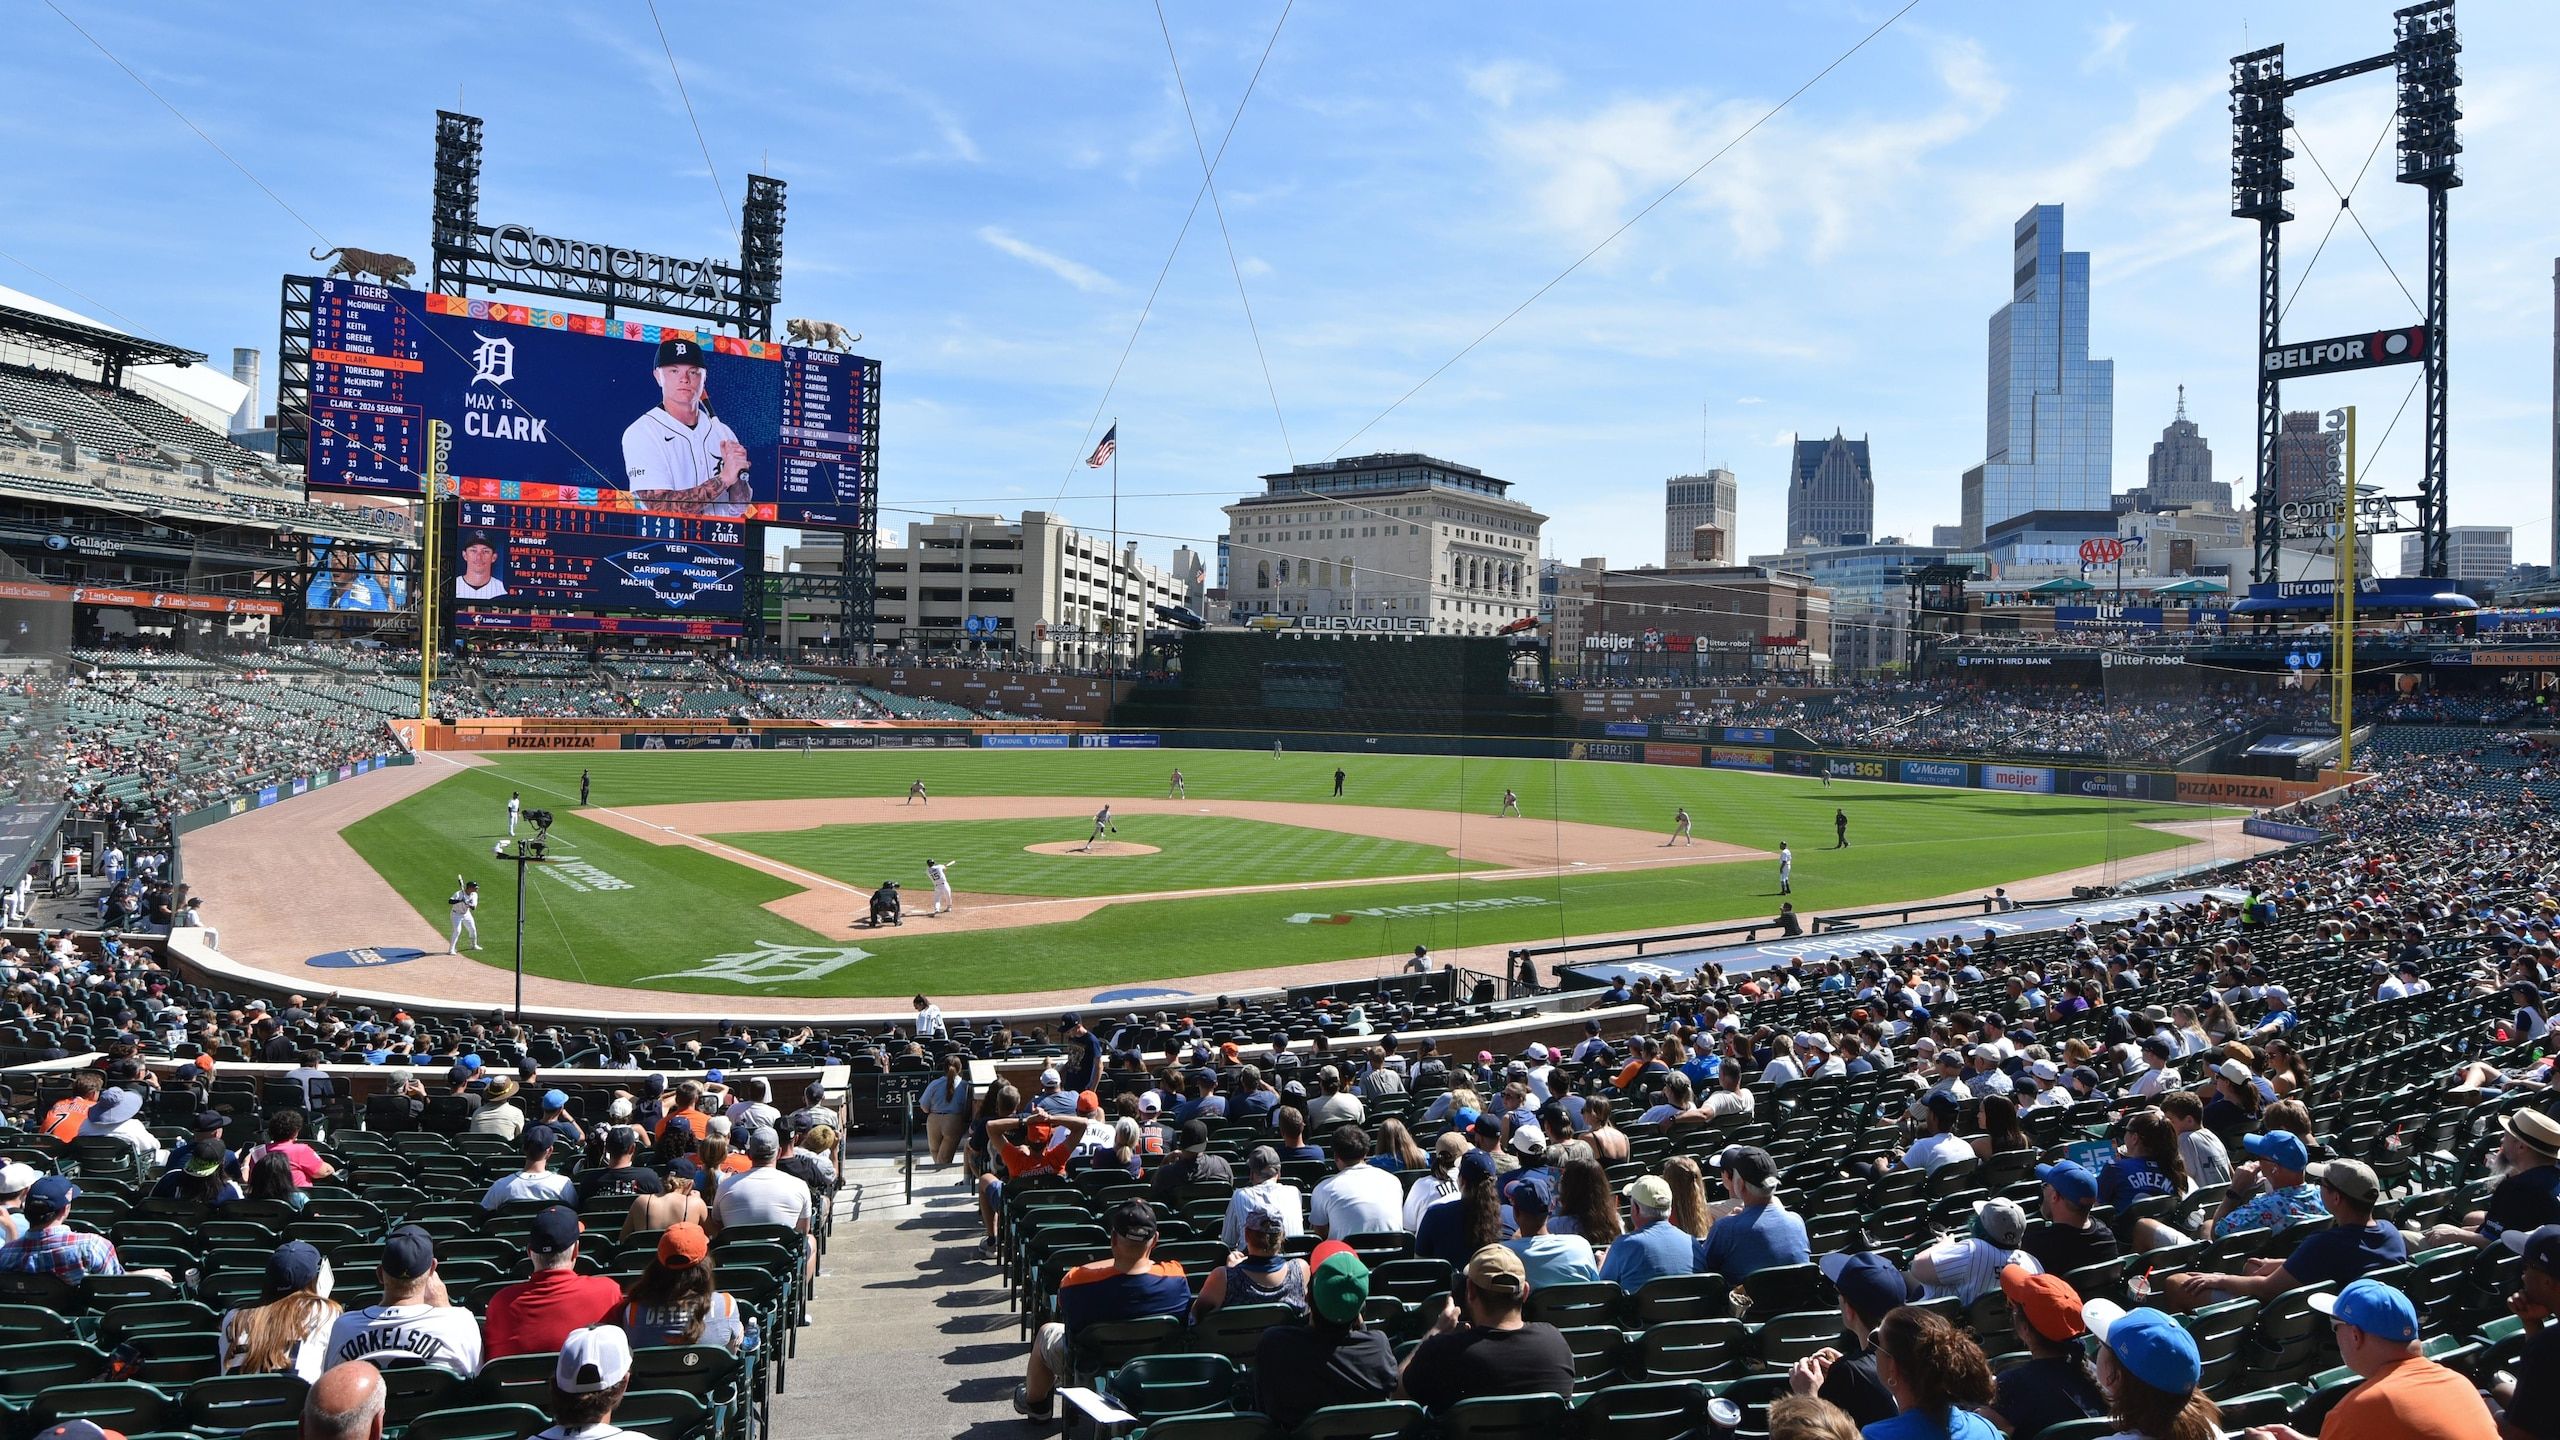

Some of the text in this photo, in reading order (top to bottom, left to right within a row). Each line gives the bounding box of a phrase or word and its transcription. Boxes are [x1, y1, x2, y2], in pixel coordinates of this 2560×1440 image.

[354, 285, 388, 299] TIGERS
[559, 273, 666, 303] PARK
[347, 300, 386, 312] McGONIGLE
[347, 311, 359, 319] LEE
[318, 318, 366, 331] 33 KEITH
[317, 329, 416, 349] 31 GREENE K
[346, 344, 375, 354] DINGLER
[345, 355, 368, 364] CLARK
[808, 351, 839, 364] ROCKIES
[2267, 340, 2365, 371] BELFOR
[345, 366, 385, 378] TORKELSON
[806, 364, 819, 372] BECK
[344, 377, 384, 389] McKINSTRY
[344, 388, 362, 397] PECK
[330, 400, 403, 414] CLARK 2026 SEASON
[465, 393, 513, 411] MAX 15
[464, 411, 547, 443] CLARK
[800, 450, 815, 458] PITCH
[790, 485, 808, 493] SLIDER
[481, 504, 675, 528] COL 0 0 1 4 0
[481, 517, 675, 539] DET 2 3 2 8 7 0
[712, 533, 738, 543] 2 OUTS
[71, 536, 125, 551] Gallagher
[79, 549, 116, 557] INSURANCE
[666, 545, 687, 553] VEEN
[627, 552, 649, 560] BECK
[692, 557, 735, 565] JOHNSTON
[634, 566, 670, 574] CARRIGG
[683, 569, 717, 577] AMADOR
[621, 578, 654, 587] MACHÍN
[693, 582, 733, 591] RUMFIELD
[655, 592, 695, 600] SULLIVAN
[2278, 583, 2304, 599] Lite
[89, 592, 134, 603] Little Caesars
[169, 597, 186, 606] Little
[2096, 604, 2124, 620] Lite
[2201, 613, 2217, 622] Lite
[373, 618, 411, 629] MARKET
[1301, 615, 1434, 632] CHEVROLET
[1275, 633, 1413, 643] FOUNTAIN
[1586, 633, 1635, 652] meijer
[1774, 647, 1797, 655] LAW
[894, 671, 904, 679] 23
[1012, 676, 1017, 684] 2
[1092, 682, 1097, 690] 6
[1681, 692, 1690, 700] 10
[1720, 690, 1728, 698] 11
[1756, 690, 1767, 698] 42
[508, 737, 595, 748] PIZZA! PIZZA!
[1083, 736, 1109, 747] DTE
[1590, 744, 1631, 755] FERRIS
[1830, 760, 1883, 777] bet365
[1921, 765, 1960, 776] McLaren
[1996, 771, 2038, 788] meijer
[2082, 780, 2118, 793] Corona
[2178, 782, 2274, 799] PIZZA! PIZZA!
[901, 1079, 907, 1088] 2
[886, 1094, 901, 1103] 3-5
[912, 1094, 916, 1103] 1
